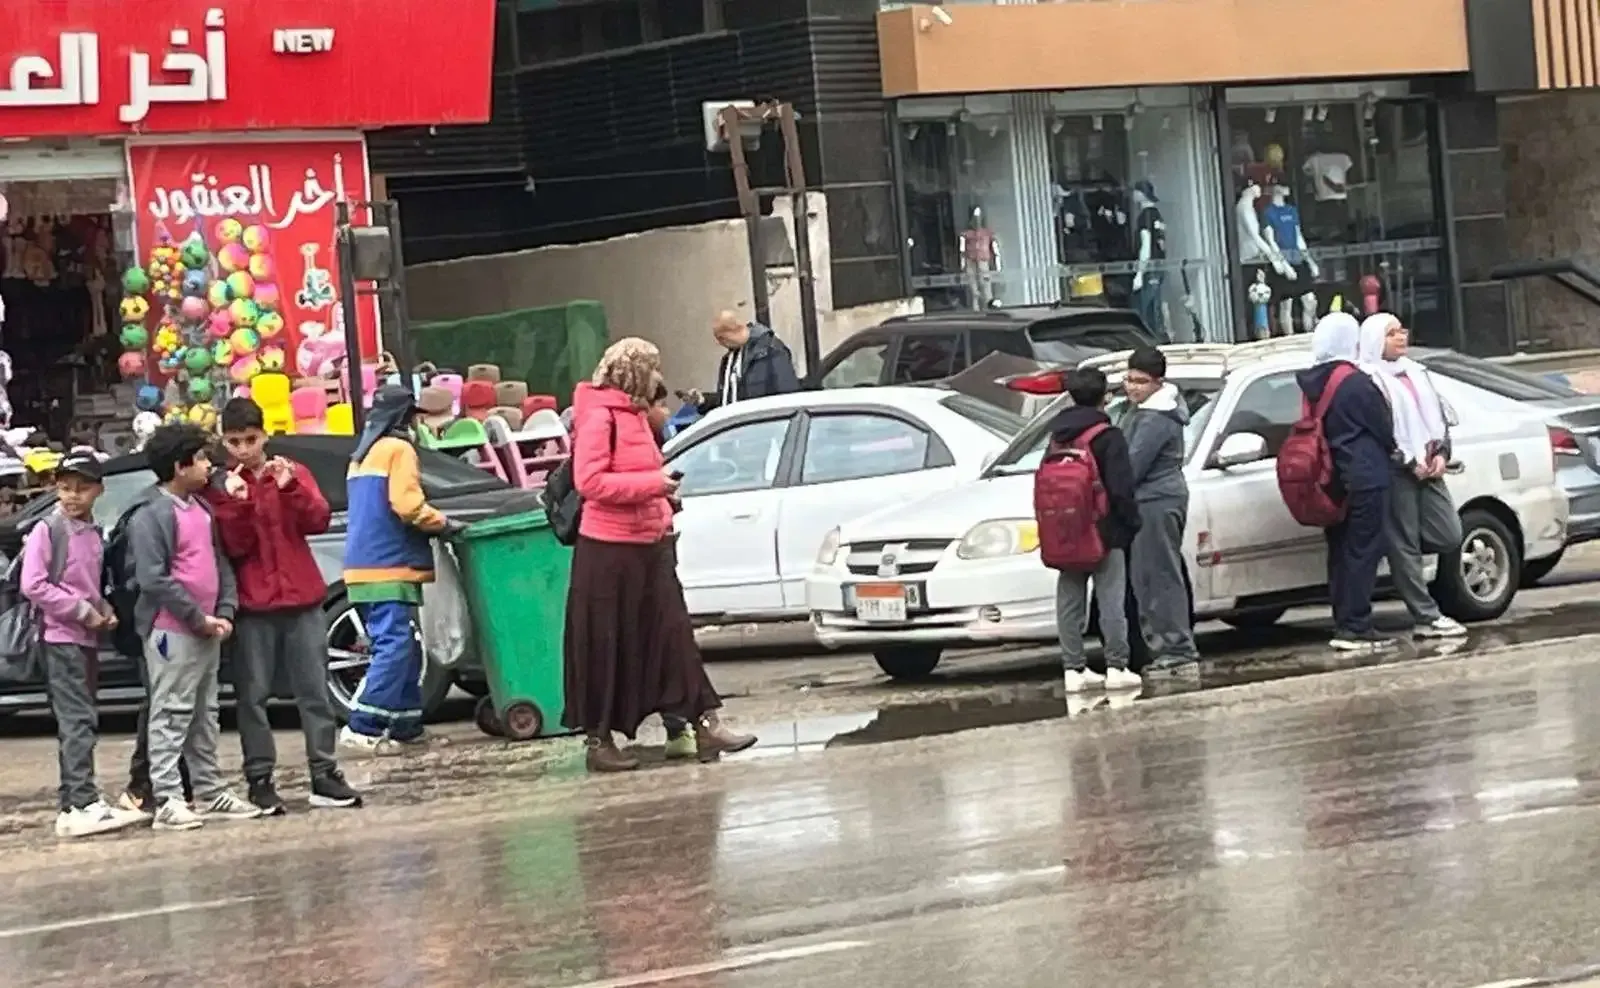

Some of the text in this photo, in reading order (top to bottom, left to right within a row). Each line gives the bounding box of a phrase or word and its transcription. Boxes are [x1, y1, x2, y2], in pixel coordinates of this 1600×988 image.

[118, 8, 227, 122] أخر
[273, 28, 335, 53] NEW
[149, 164, 277, 225] العنقود
